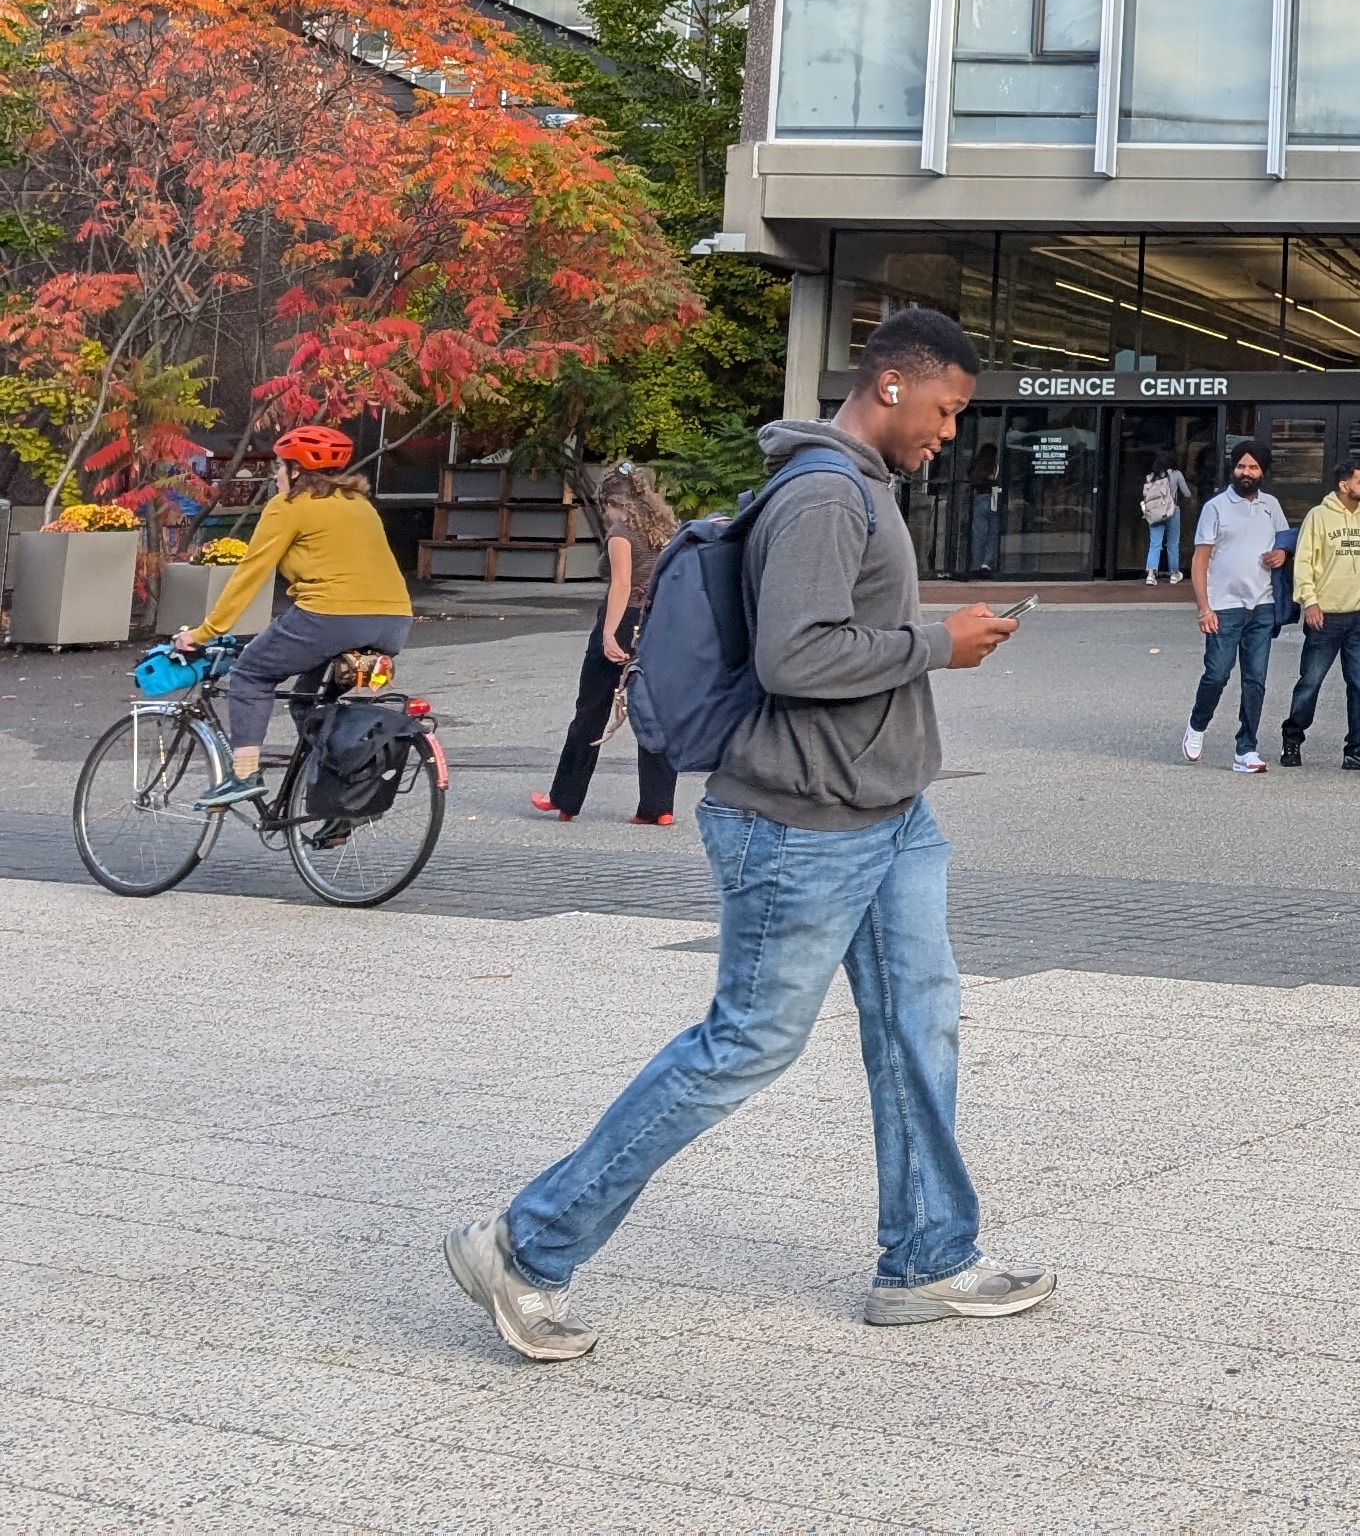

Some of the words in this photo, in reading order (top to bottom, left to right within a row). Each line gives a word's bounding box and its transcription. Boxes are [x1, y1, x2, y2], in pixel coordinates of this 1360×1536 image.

[1018, 377, 1116, 396] SCIENCE
[1140, 377, 1228, 396] CENTER
[950, 1270, 979, 1293] N
[517, 1292, 545, 1315] N
